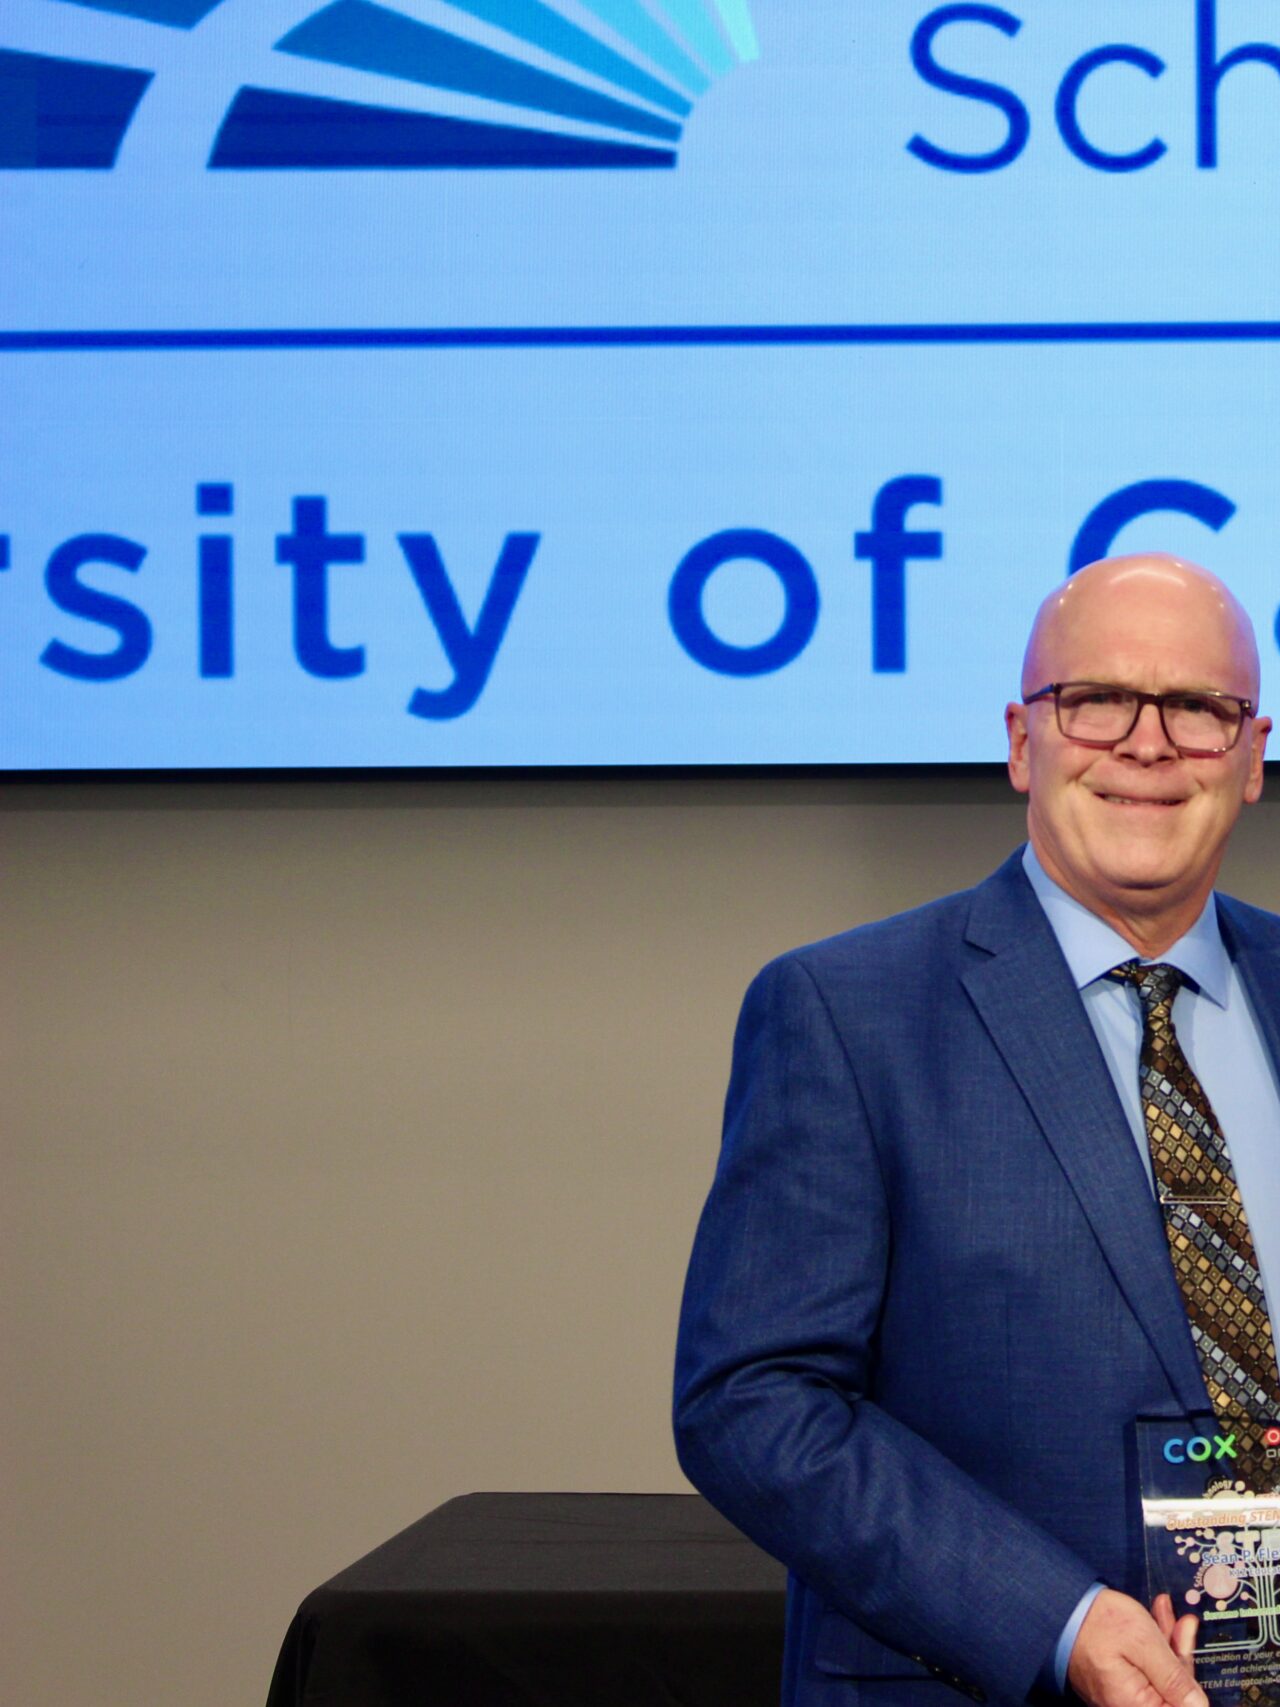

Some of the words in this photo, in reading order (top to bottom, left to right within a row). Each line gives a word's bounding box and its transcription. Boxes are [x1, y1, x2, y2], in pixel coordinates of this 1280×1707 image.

[0, 482, 542, 722] sity
[667, 475, 943, 679] of
[1163, 1433, 1238, 1464] COX
[1166, 1511, 1247, 1531] Outstanding
[1202, 1551, 1238, 1566] Sean
[1242, 1549, 1255, 1561] P.
[1243, 1650, 1253, 1663] of
[1253, 1651, 1274, 1662] your
[1221, 1665, 1238, 1675] and
[1224, 1677, 1263, 1688] Educator
